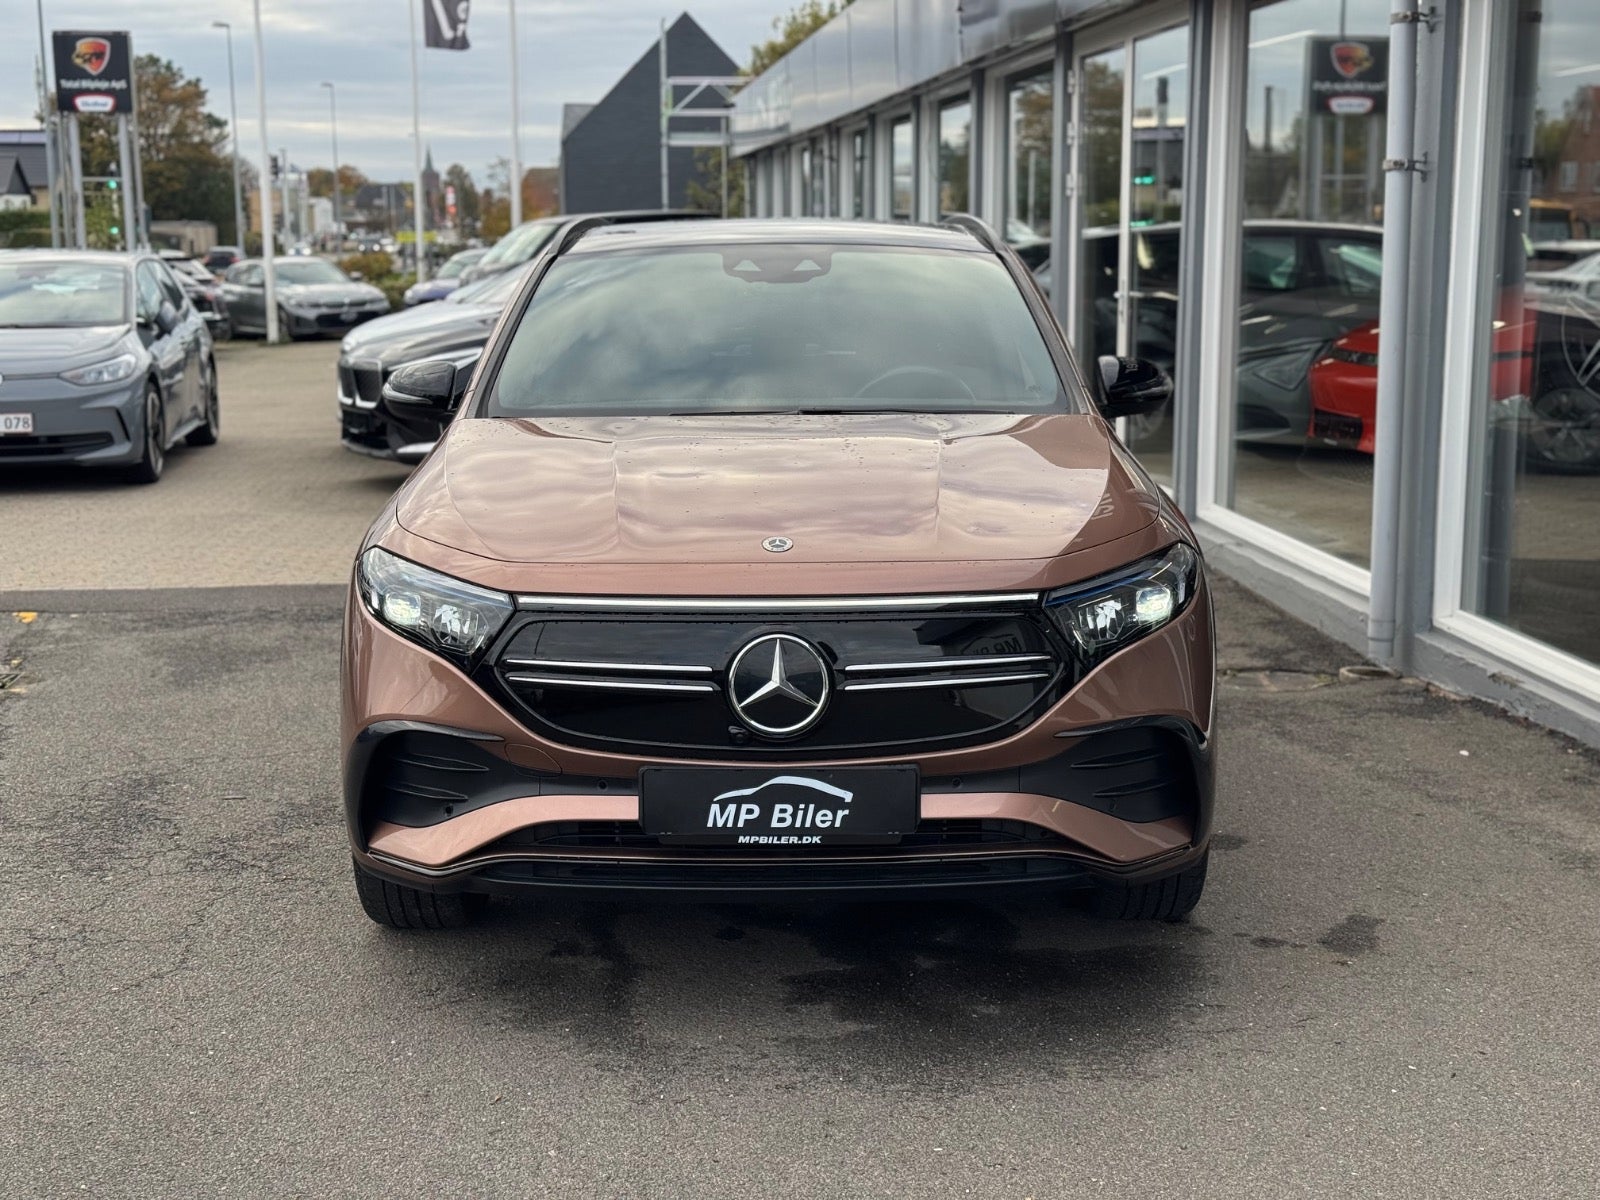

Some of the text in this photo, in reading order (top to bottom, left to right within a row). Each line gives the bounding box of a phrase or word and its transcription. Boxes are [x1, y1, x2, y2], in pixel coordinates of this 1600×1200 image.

[4, 416, 31, 430] 078
[706, 803, 850, 828] MP Biler
[737, 835, 823, 844] MPBILER.DK
